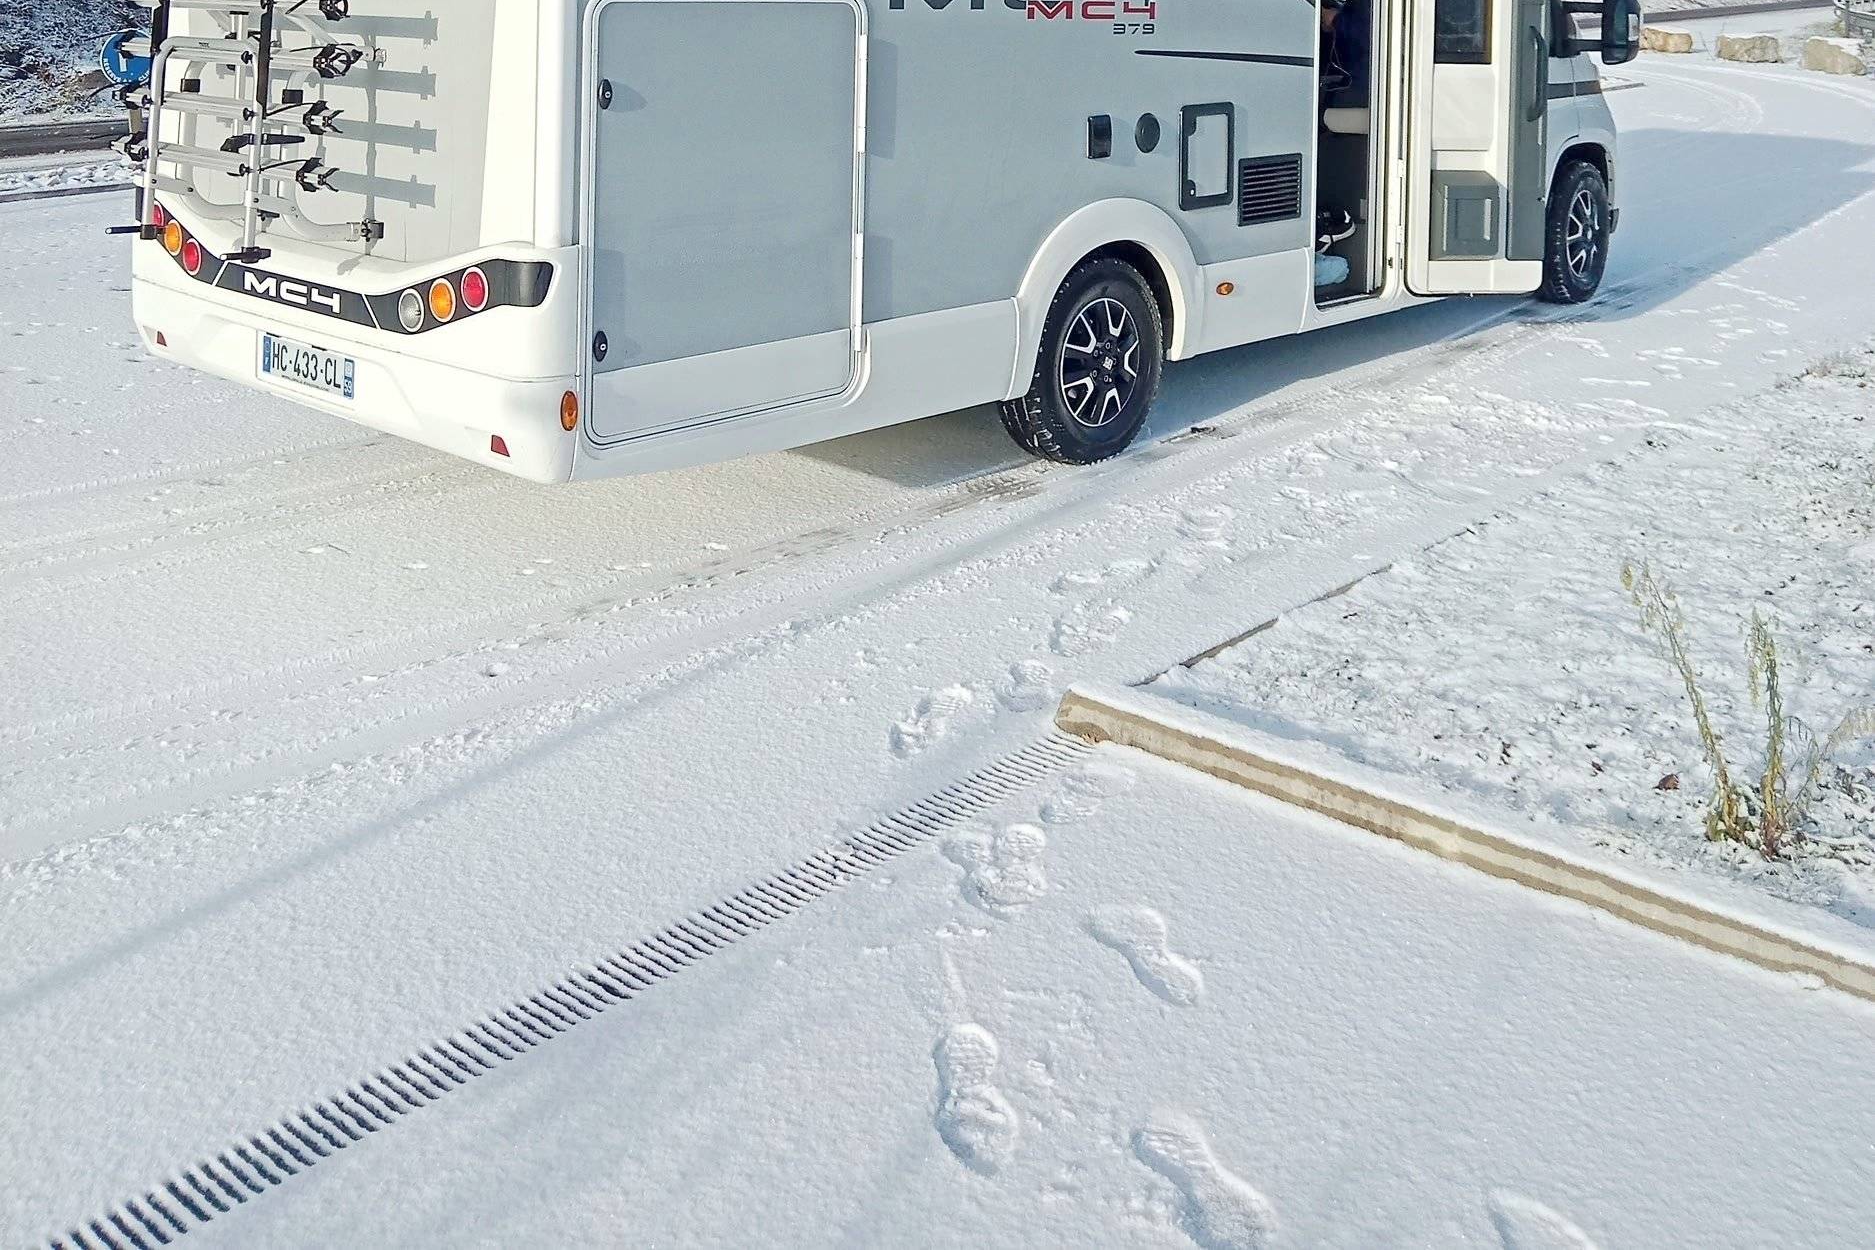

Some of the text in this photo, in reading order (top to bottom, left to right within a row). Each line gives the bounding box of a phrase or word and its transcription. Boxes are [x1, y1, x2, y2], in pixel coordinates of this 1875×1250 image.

[1027, 0, 1156, 20] MC4
[1112, 23, 1156, 35] 379
[243, 270, 341, 314] MC4
